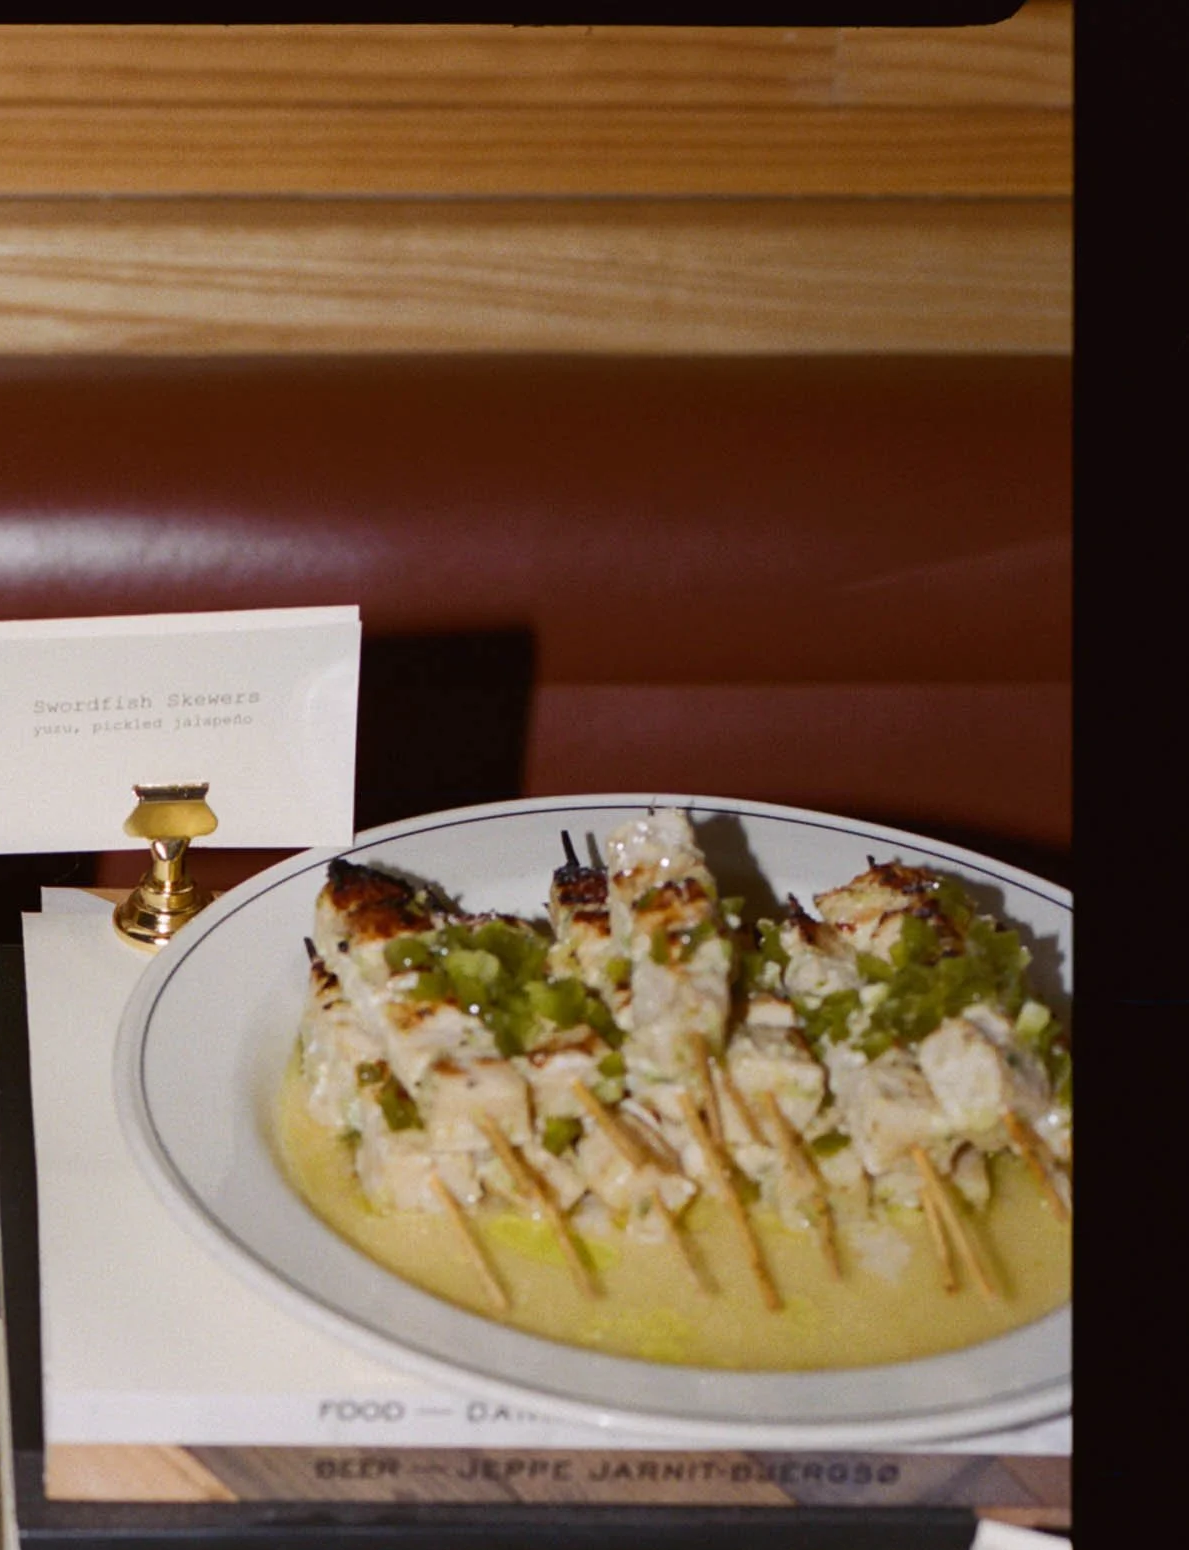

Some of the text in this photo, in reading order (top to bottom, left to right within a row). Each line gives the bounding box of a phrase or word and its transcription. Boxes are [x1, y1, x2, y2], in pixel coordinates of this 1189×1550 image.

[32, 688, 262, 714] Swordfish Skewers
[31, 721, 81, 737] yuzu,
[91, 716, 163, 735] pickled
[318, 1401, 406, 1423] FOOD
[456, 1457, 573, 1482] JEPPE
